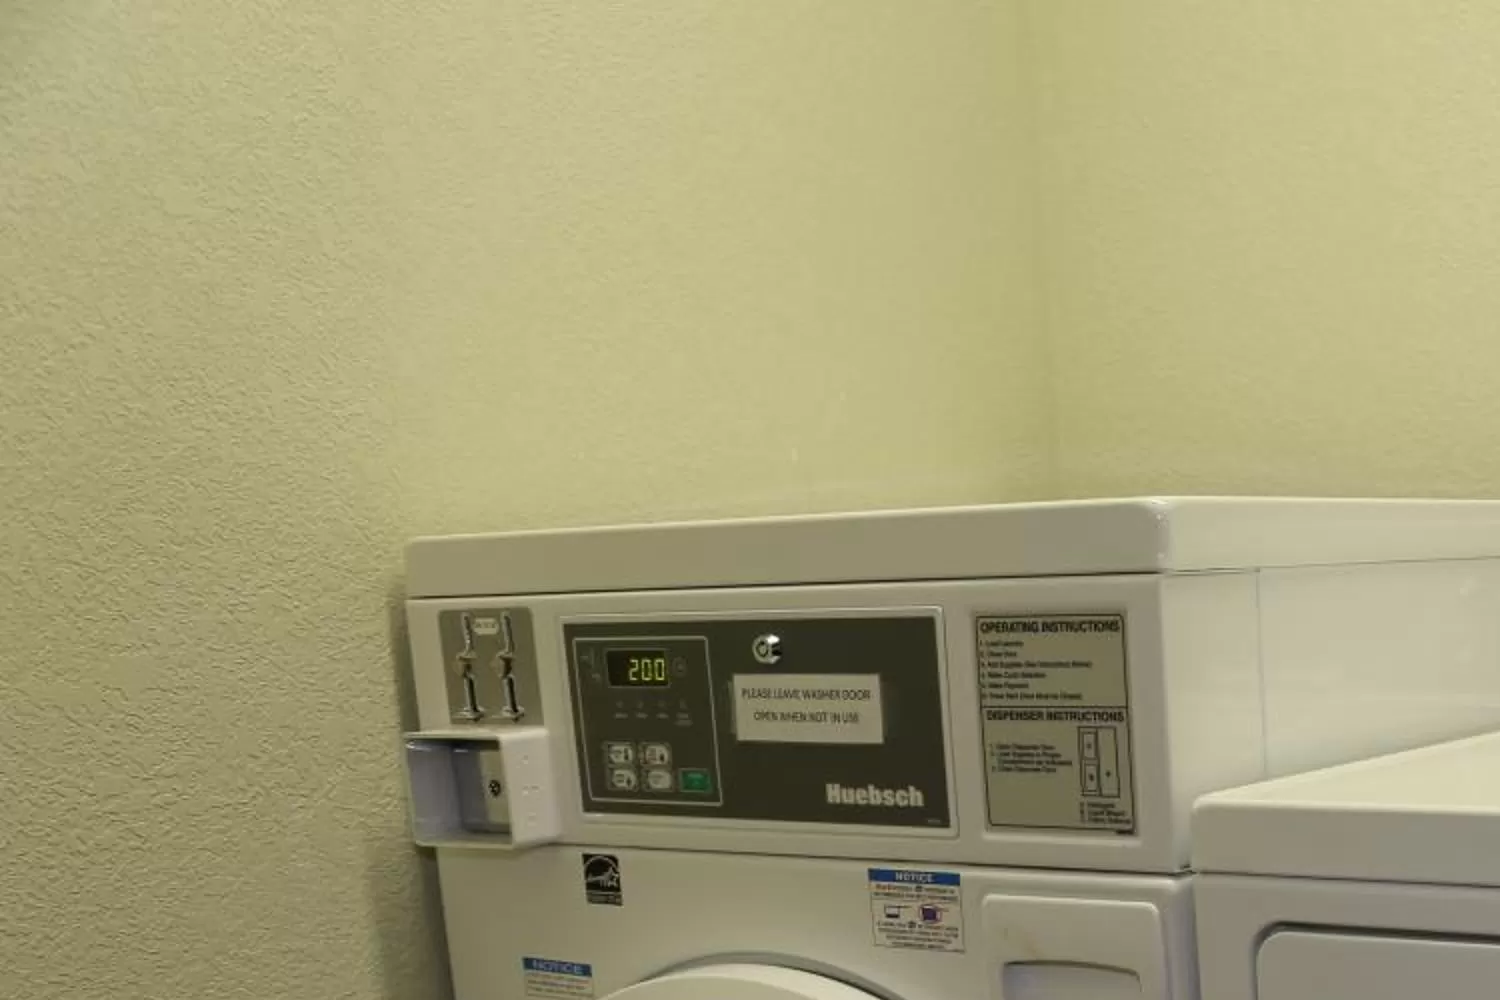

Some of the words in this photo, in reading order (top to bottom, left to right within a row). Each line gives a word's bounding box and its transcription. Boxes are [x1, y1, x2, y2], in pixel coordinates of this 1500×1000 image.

[980, 621, 1039, 634] OPERATING
[1041, 620, 1120, 633] INSTRUCTIONS
[629, 658, 665, 681] 200
[741, 687, 771, 699] PLEASE
[773, 688, 800, 700] LEAVE
[802, 688, 840, 700] WASHER
[841, 689, 871, 701] DOOR
[753, 711, 779, 721] OPEN
[780, 711, 807, 722] WHEN
[809, 711, 827, 722] NOT
[830, 711, 841, 724] IN
[986, 710, 1044, 721] DISPENSER
[1046, 711, 1124, 722] INSTRUCTIONS
[825, 783, 924, 807] Huebsch
[895, 872, 933, 883] NOTICE
[532, 959, 583, 975] NOTICE
